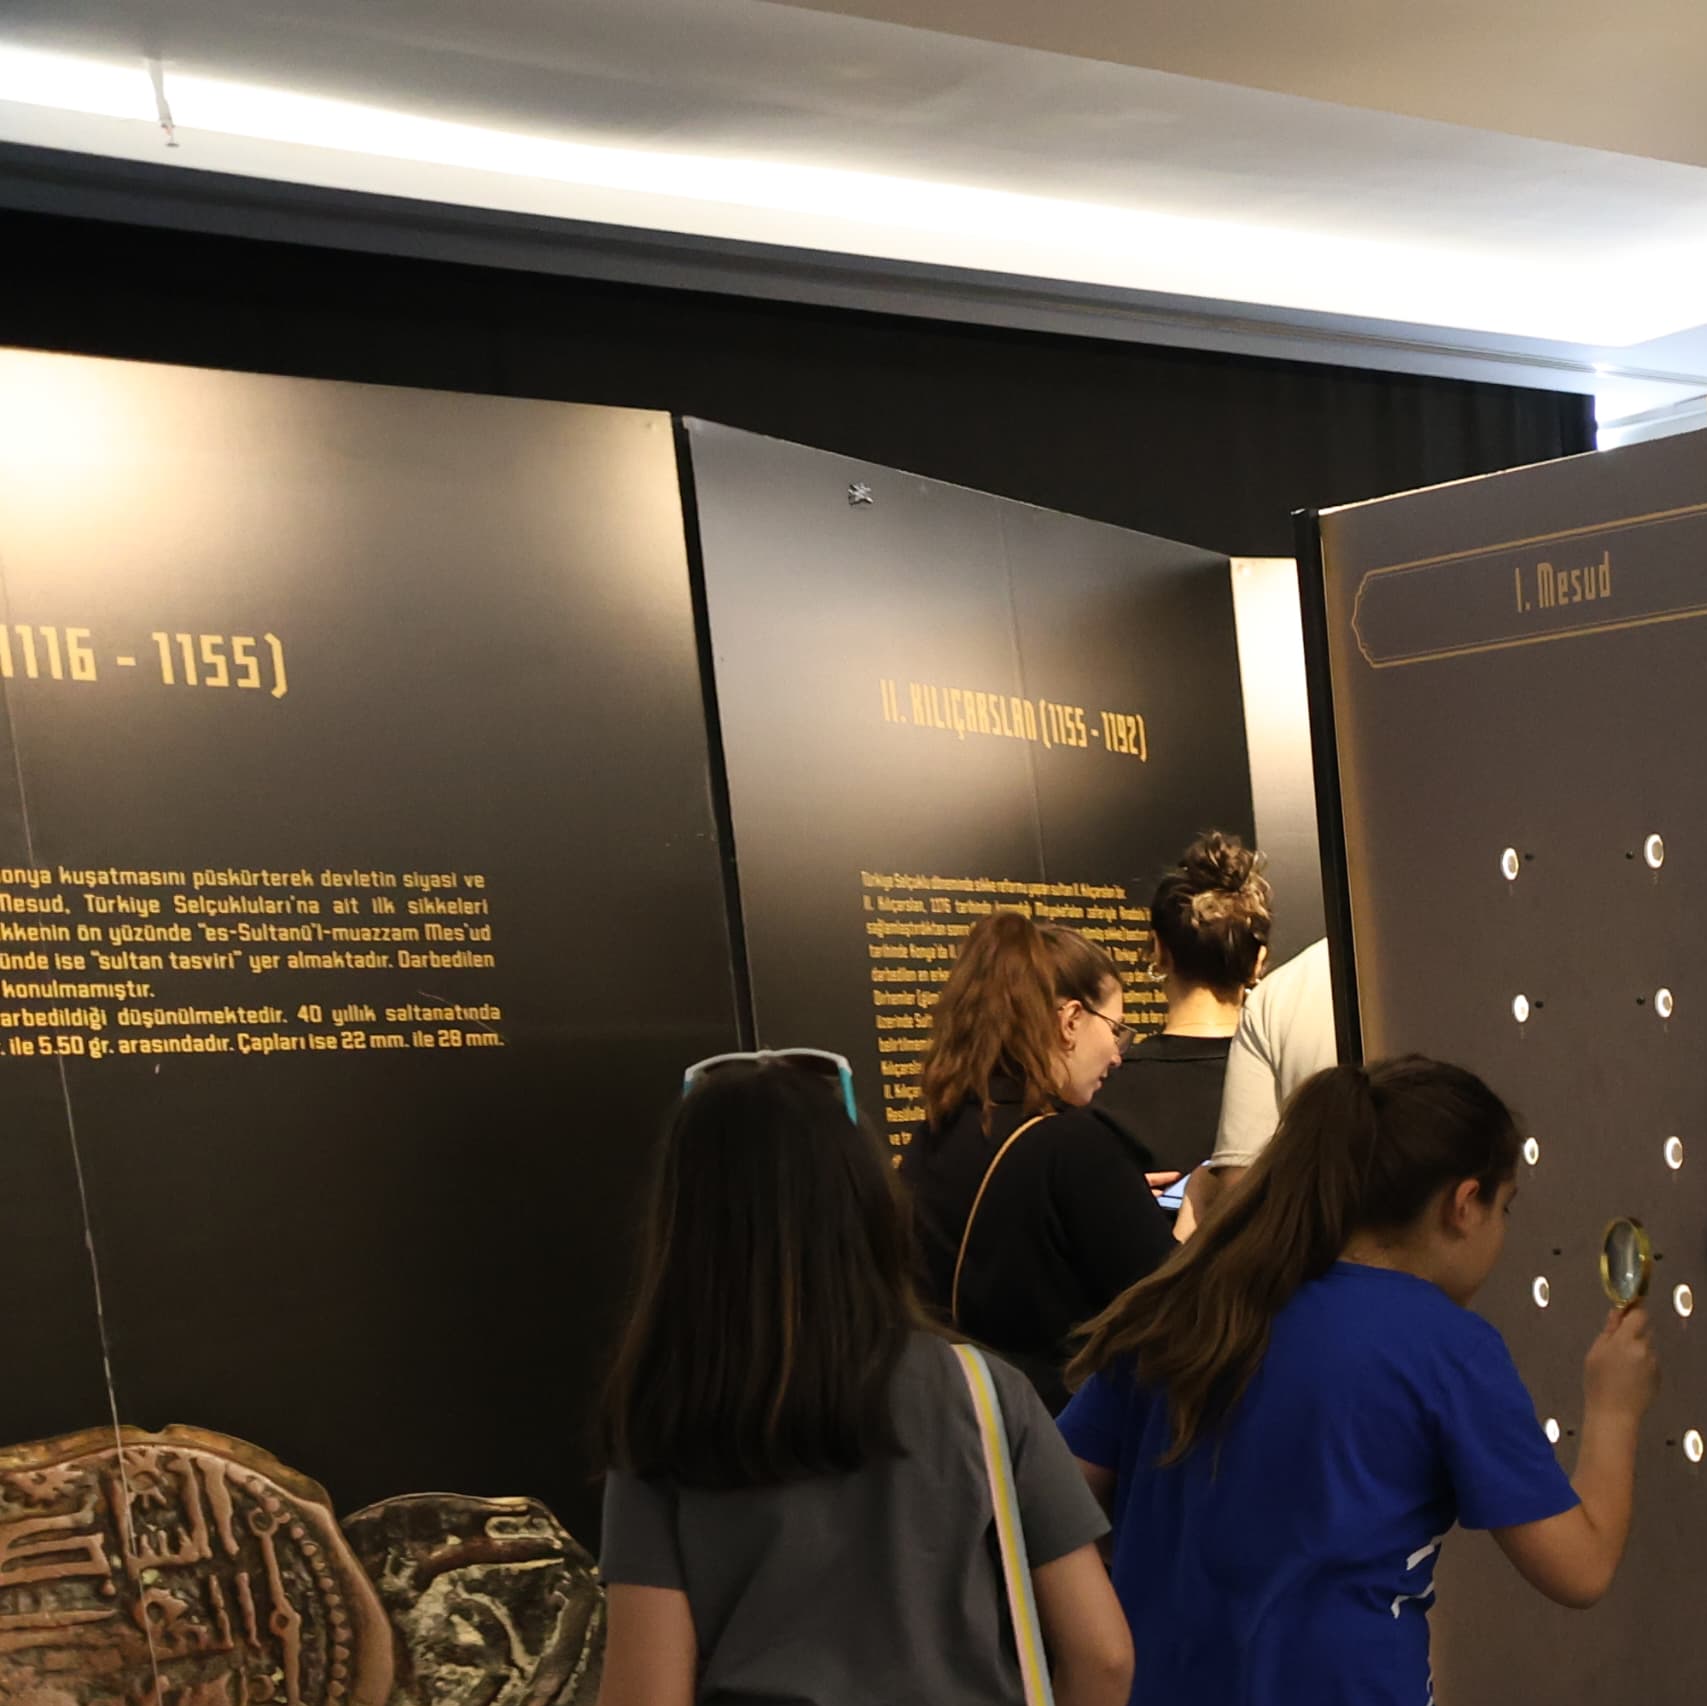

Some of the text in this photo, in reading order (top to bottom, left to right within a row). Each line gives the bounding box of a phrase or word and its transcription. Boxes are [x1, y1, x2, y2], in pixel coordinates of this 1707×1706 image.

[1515, 551, 1611, 613] I. Mesud
[152, 632, 288, 699] 1155)
[880, 679, 906, 723] II.
[1040, 699, 1088, 749] (1155
[1101, 711, 1147, 762] 1192)
[59, 866, 186, 888] kuşatmasını
[193, 868, 314, 890] püskürterek
[321, 869, 396, 887] devletin
[403, 871, 457, 892] siyasi
[464, 873, 485, 888] ve
[84, 894, 160, 918] Türkiye
[333, 898, 359, 914] ait
[372, 897, 396, 914] ilk
[407, 897, 488, 914] sikkeleri
[77, 924, 102, 942] ön
[109, 924, 192, 946] yüzünde
[55, 952, 86, 970] ise
[250, 955, 280, 974] yer
[287, 951, 394, 969] almaktadır.
[398, 950, 495, 968] Darbedilen
[1, 979, 155, 1000] konulmamıştır.
[117, 1004, 288, 1028] düşünülmektedir.
[297, 1005, 322, 1023] 40
[332, 1004, 376, 1027] yıllık
[385, 1003, 501, 1022] saltanatında
[9, 1029, 504, 1059] ile 5.50 gr. arasındadır. Çapları ise 22 mm. ile 28 mm.
